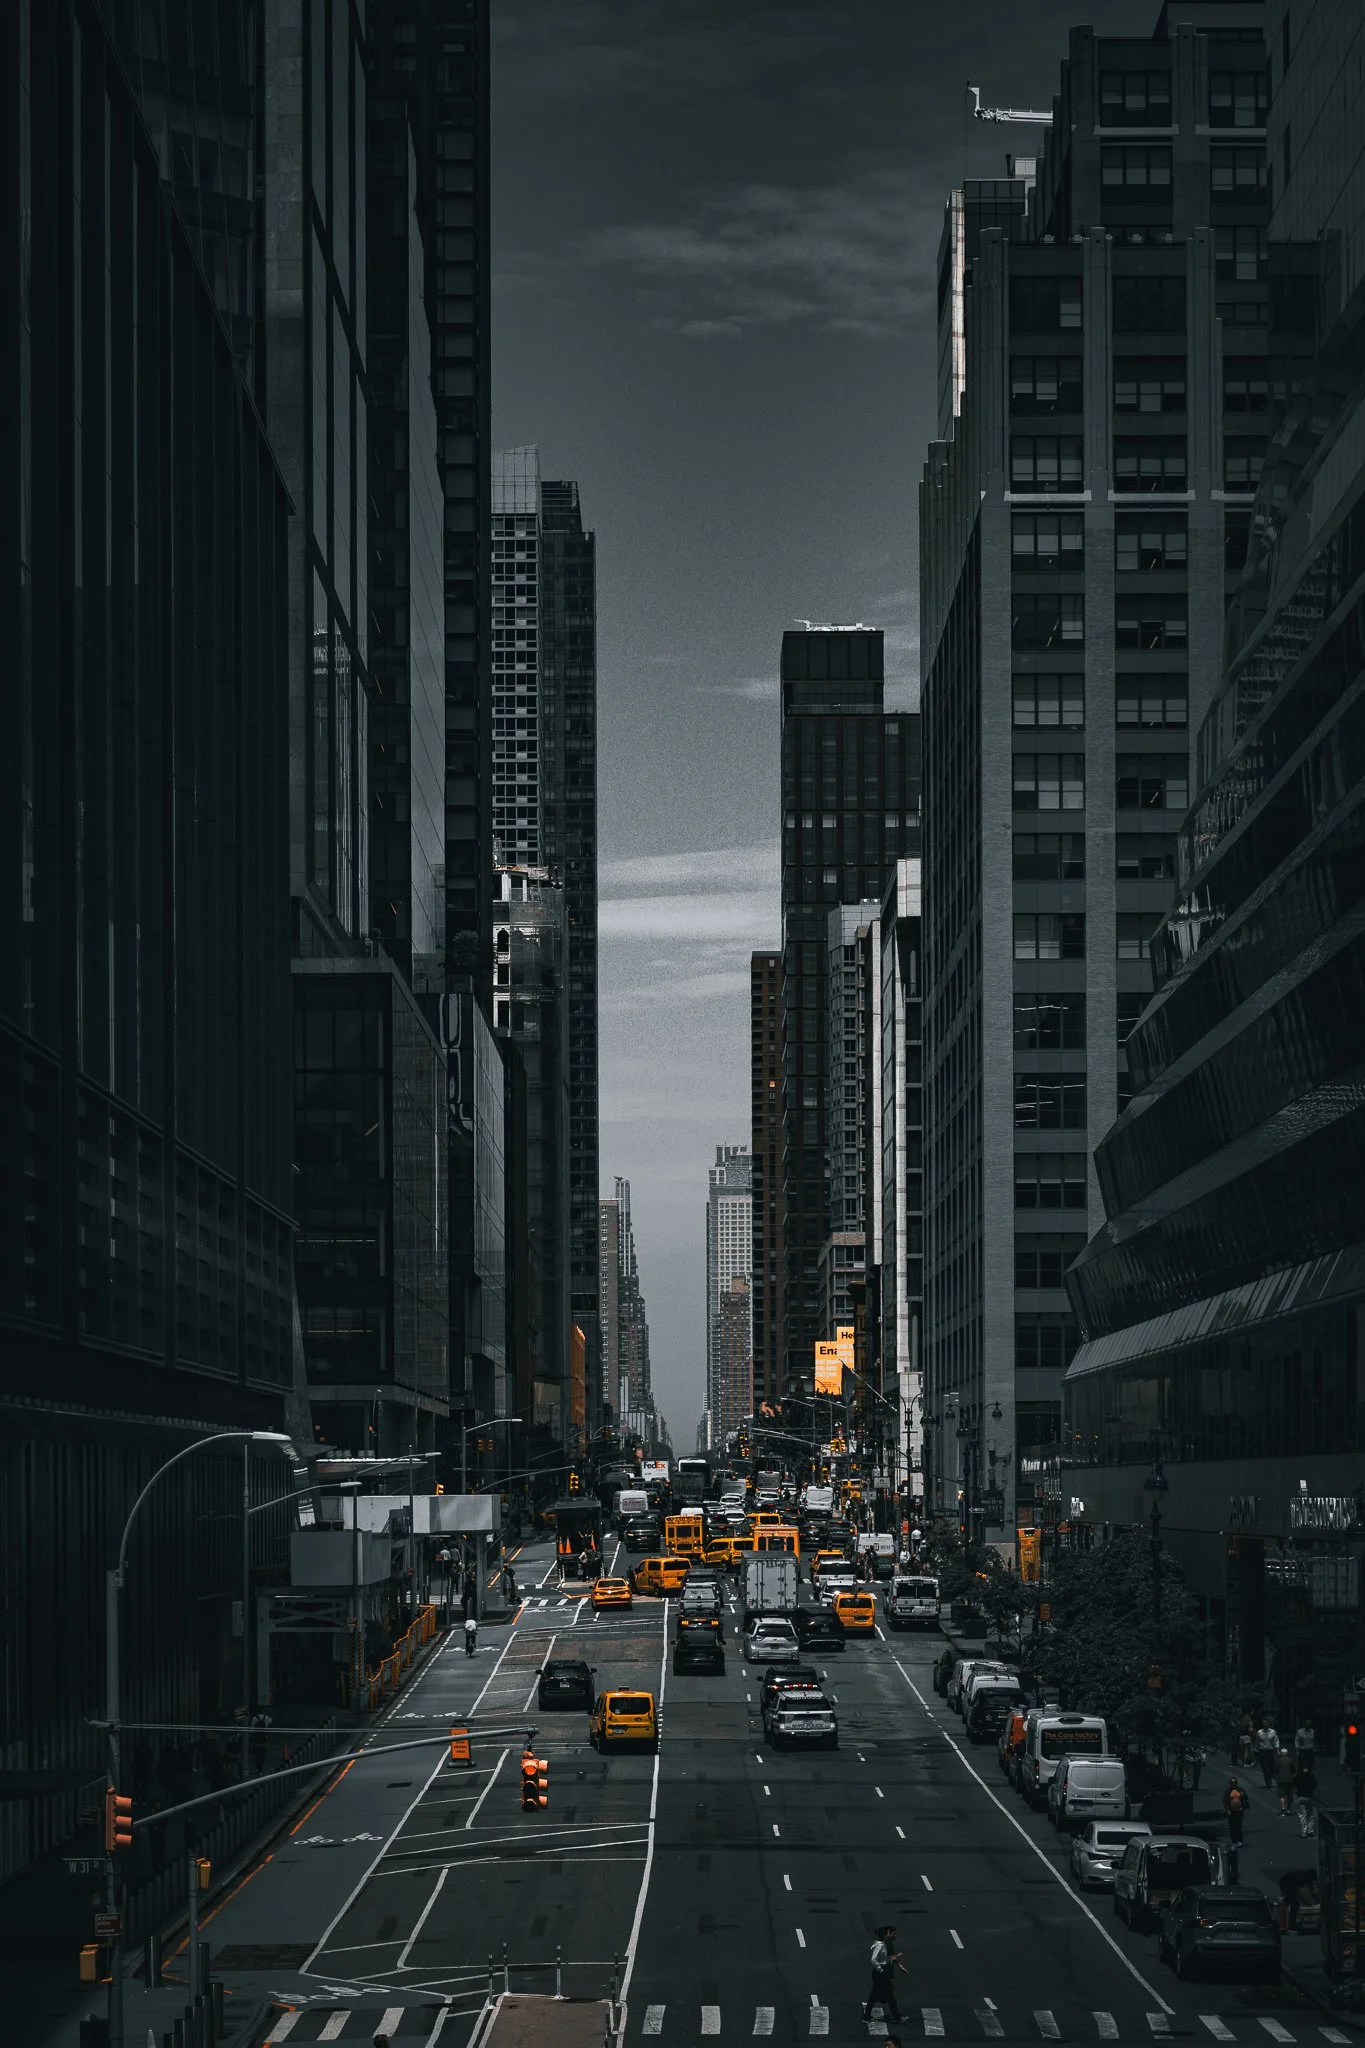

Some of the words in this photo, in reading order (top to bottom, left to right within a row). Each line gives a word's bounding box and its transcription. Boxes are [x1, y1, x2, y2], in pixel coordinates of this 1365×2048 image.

[643, 1461, 666, 1469] FedEx
[69, 1861, 77, 1873] W
[80, 1861, 90, 1873] 31
